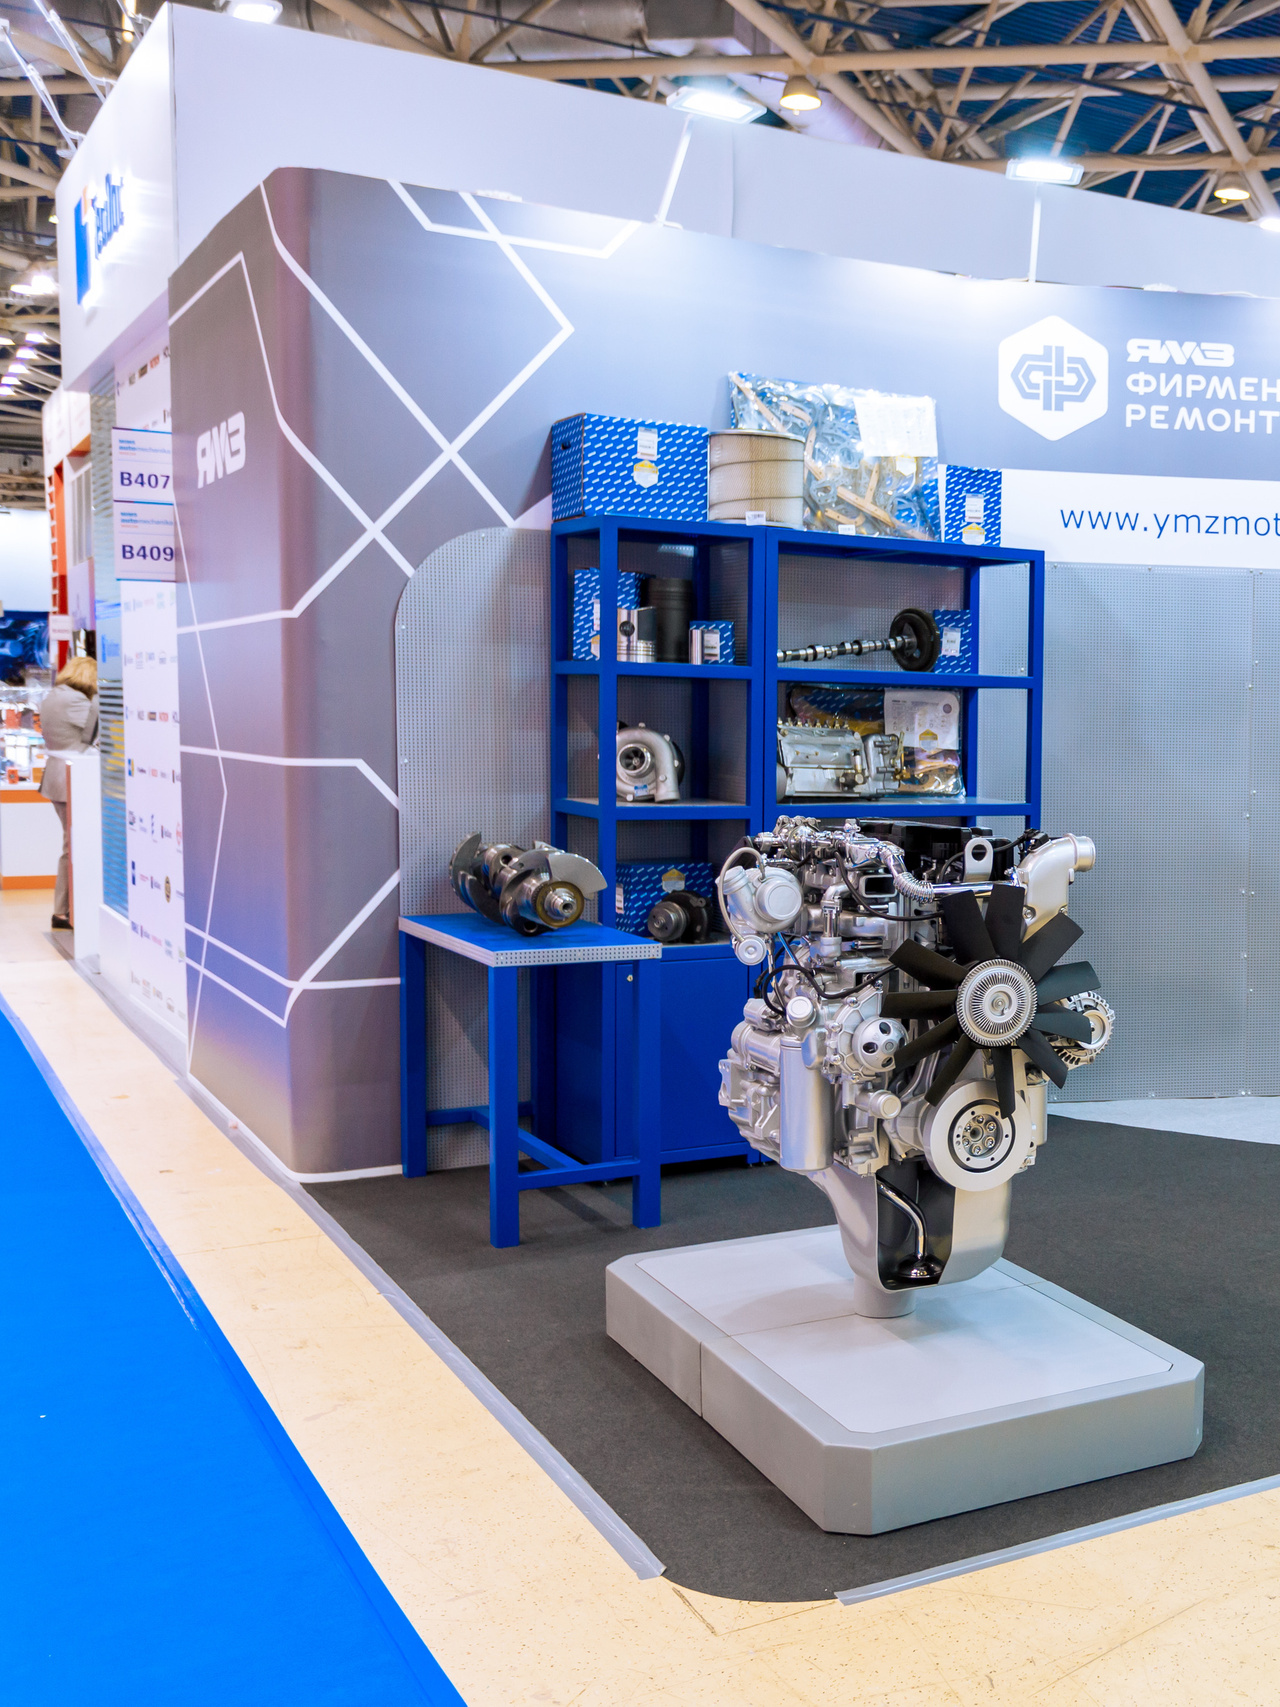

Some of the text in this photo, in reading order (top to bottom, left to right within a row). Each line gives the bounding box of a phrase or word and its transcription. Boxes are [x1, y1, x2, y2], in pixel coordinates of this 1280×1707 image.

[1126, 338, 1235, 368] ЯМЗ
[1126, 403, 1280, 434] РЕМОНТ
[196, 410, 246, 489] ЯМЗ
[120, 471, 170, 489] B407
[122, 544, 174, 562] B409
